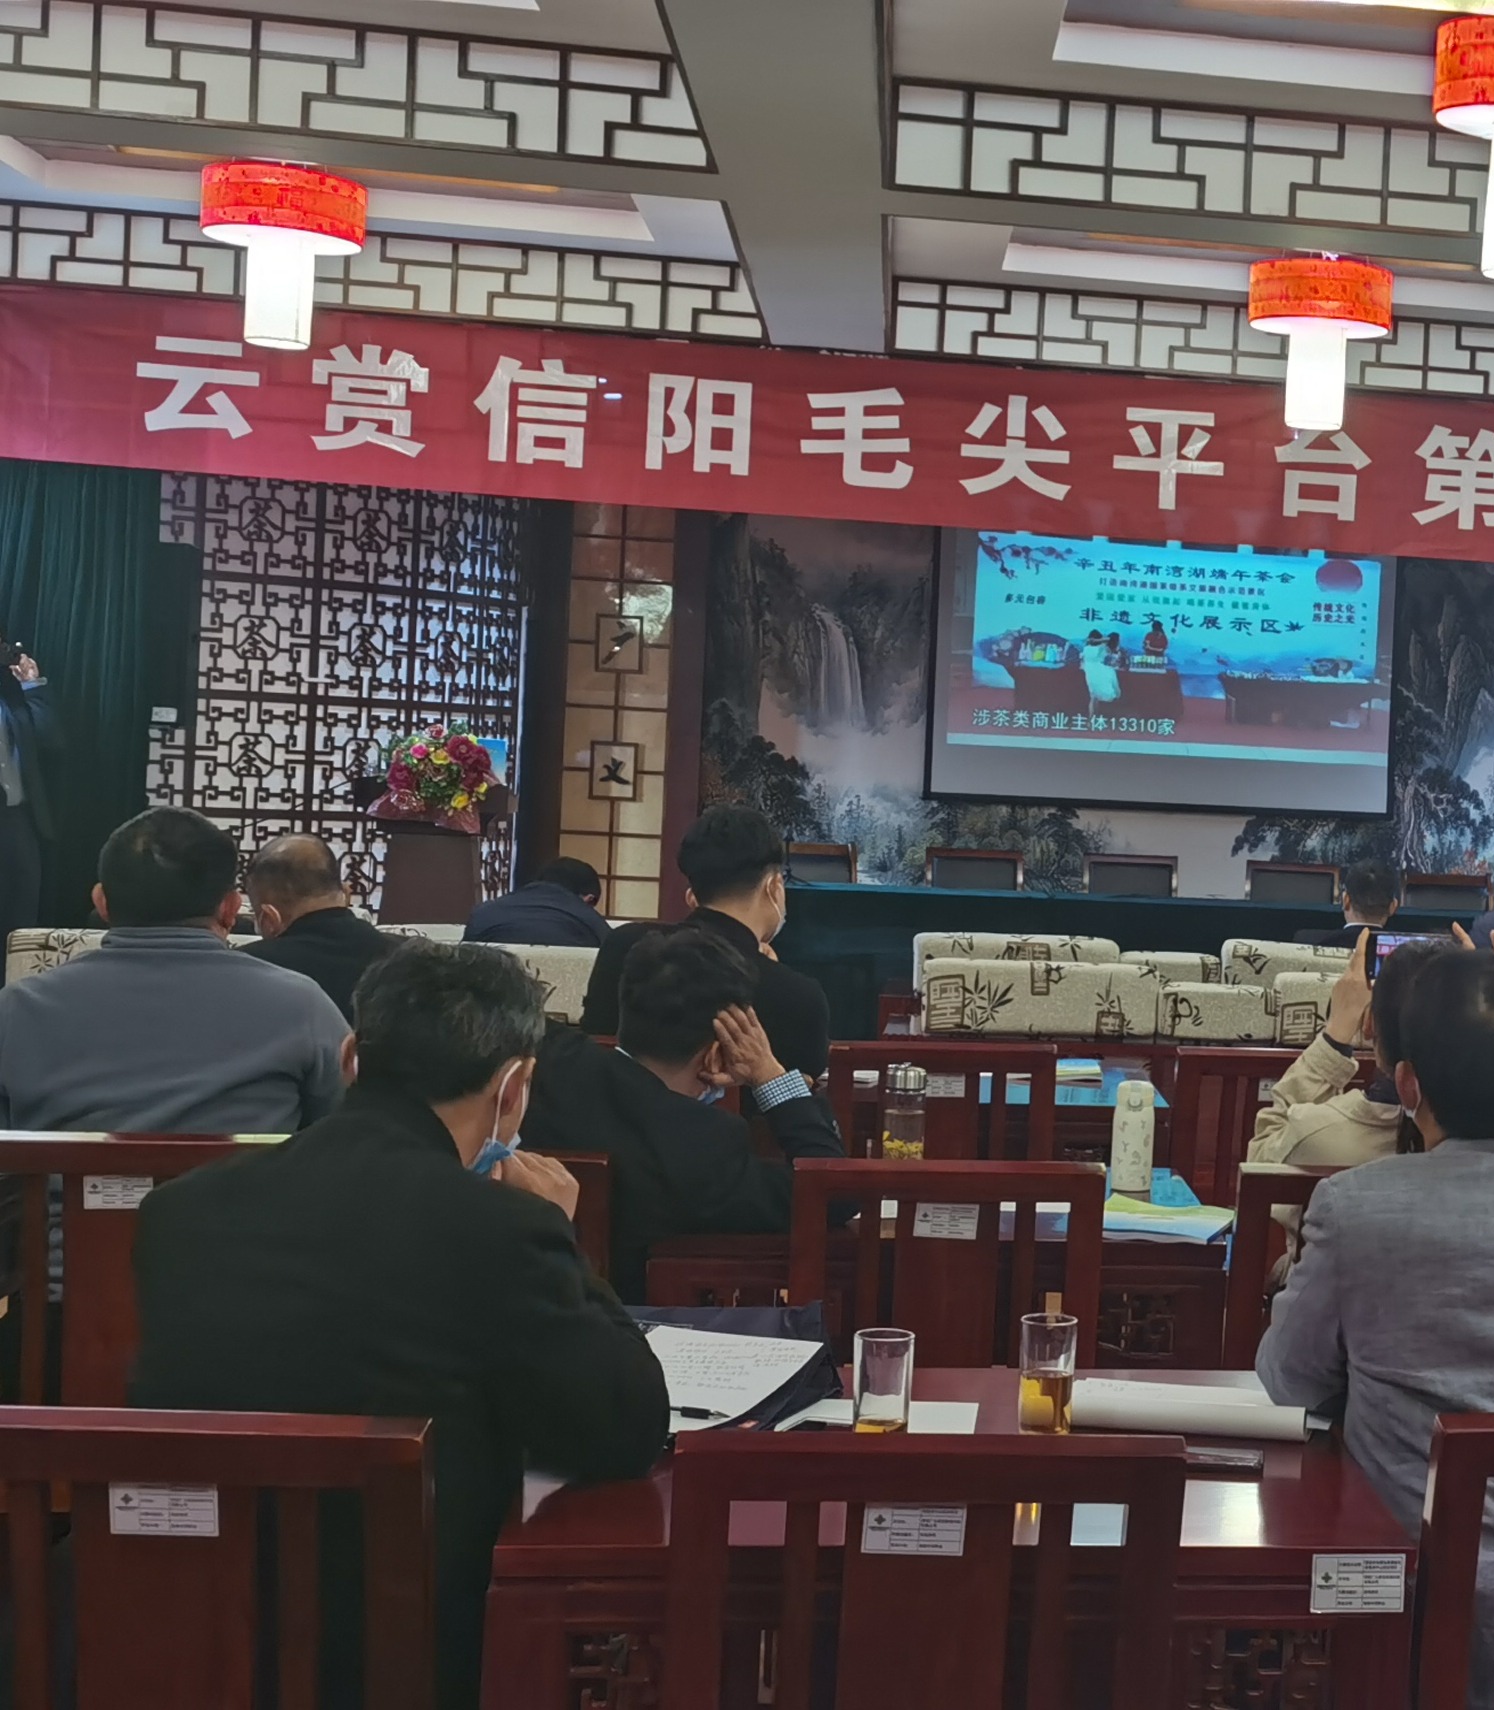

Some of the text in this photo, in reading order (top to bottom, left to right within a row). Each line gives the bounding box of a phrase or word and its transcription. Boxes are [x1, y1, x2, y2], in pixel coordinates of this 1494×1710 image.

[242, 499, 282, 542] 茶
[354, 511, 390, 551] 茶
[1074, 557, 1296, 584] 辛丑年南湾湖端午茶会
[237, 619, 278, 660] 茶
[1079, 607, 1282, 636] 非遗文化展示区
[353, 627, 386, 667] 茶
[972, 708, 1176, 736] 涉茶类商业主体13310家
[232, 736, 273, 776] 茶
